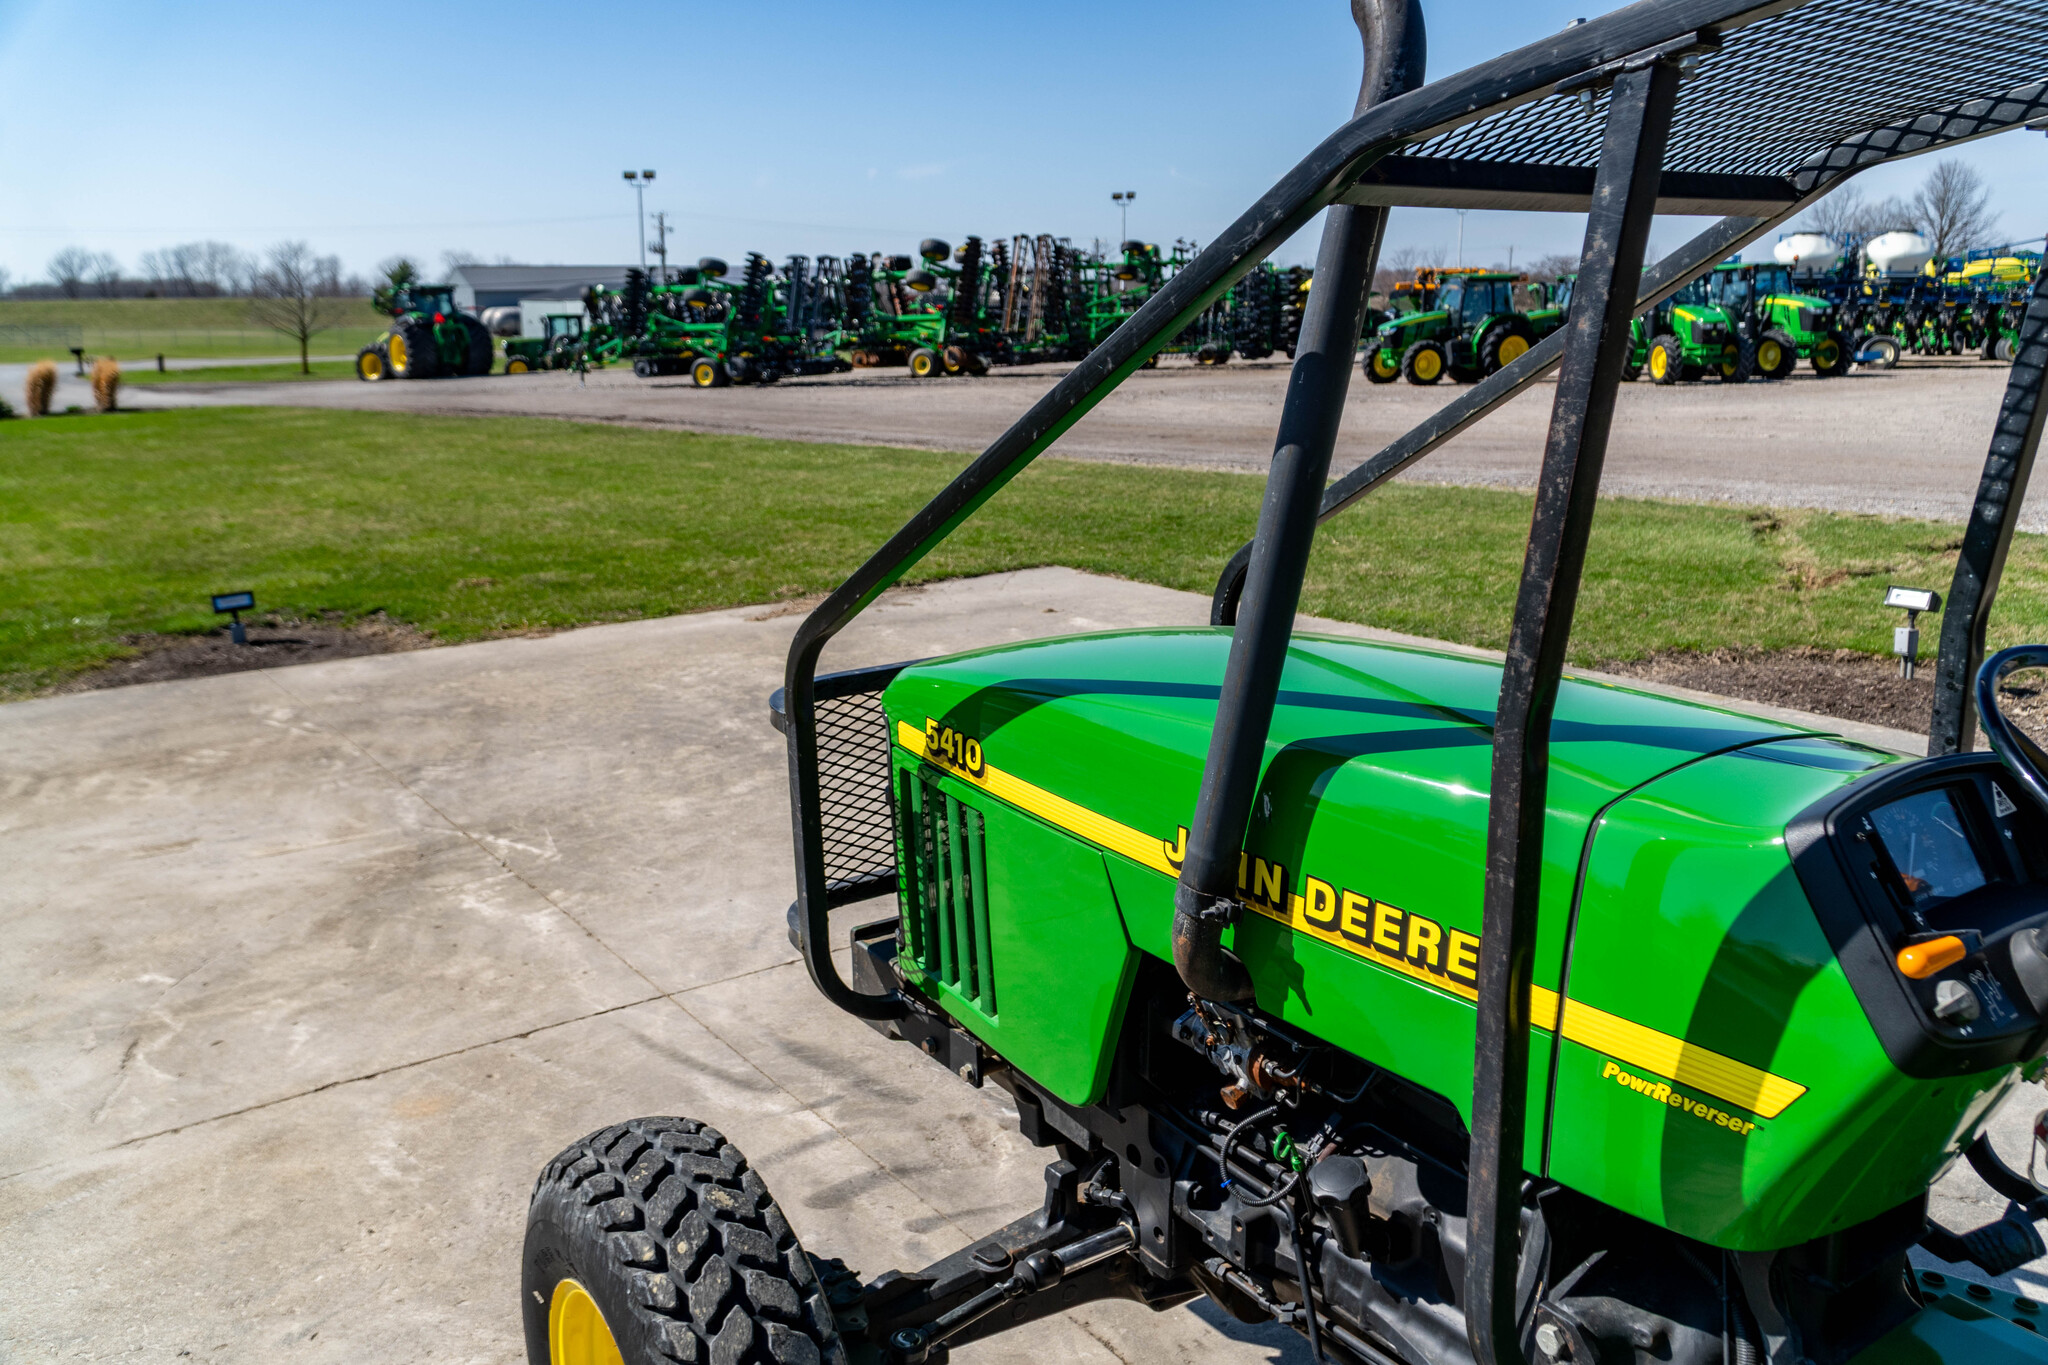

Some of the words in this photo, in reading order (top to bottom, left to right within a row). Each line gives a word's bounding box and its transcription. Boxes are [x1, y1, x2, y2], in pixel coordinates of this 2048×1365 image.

[926, 716, 984, 777] 5410
[1164, 825, 1288, 912] JN
[1303, 875, 1481, 988] DEERE
[1602, 1061, 1756, 1136] PowrReverser
